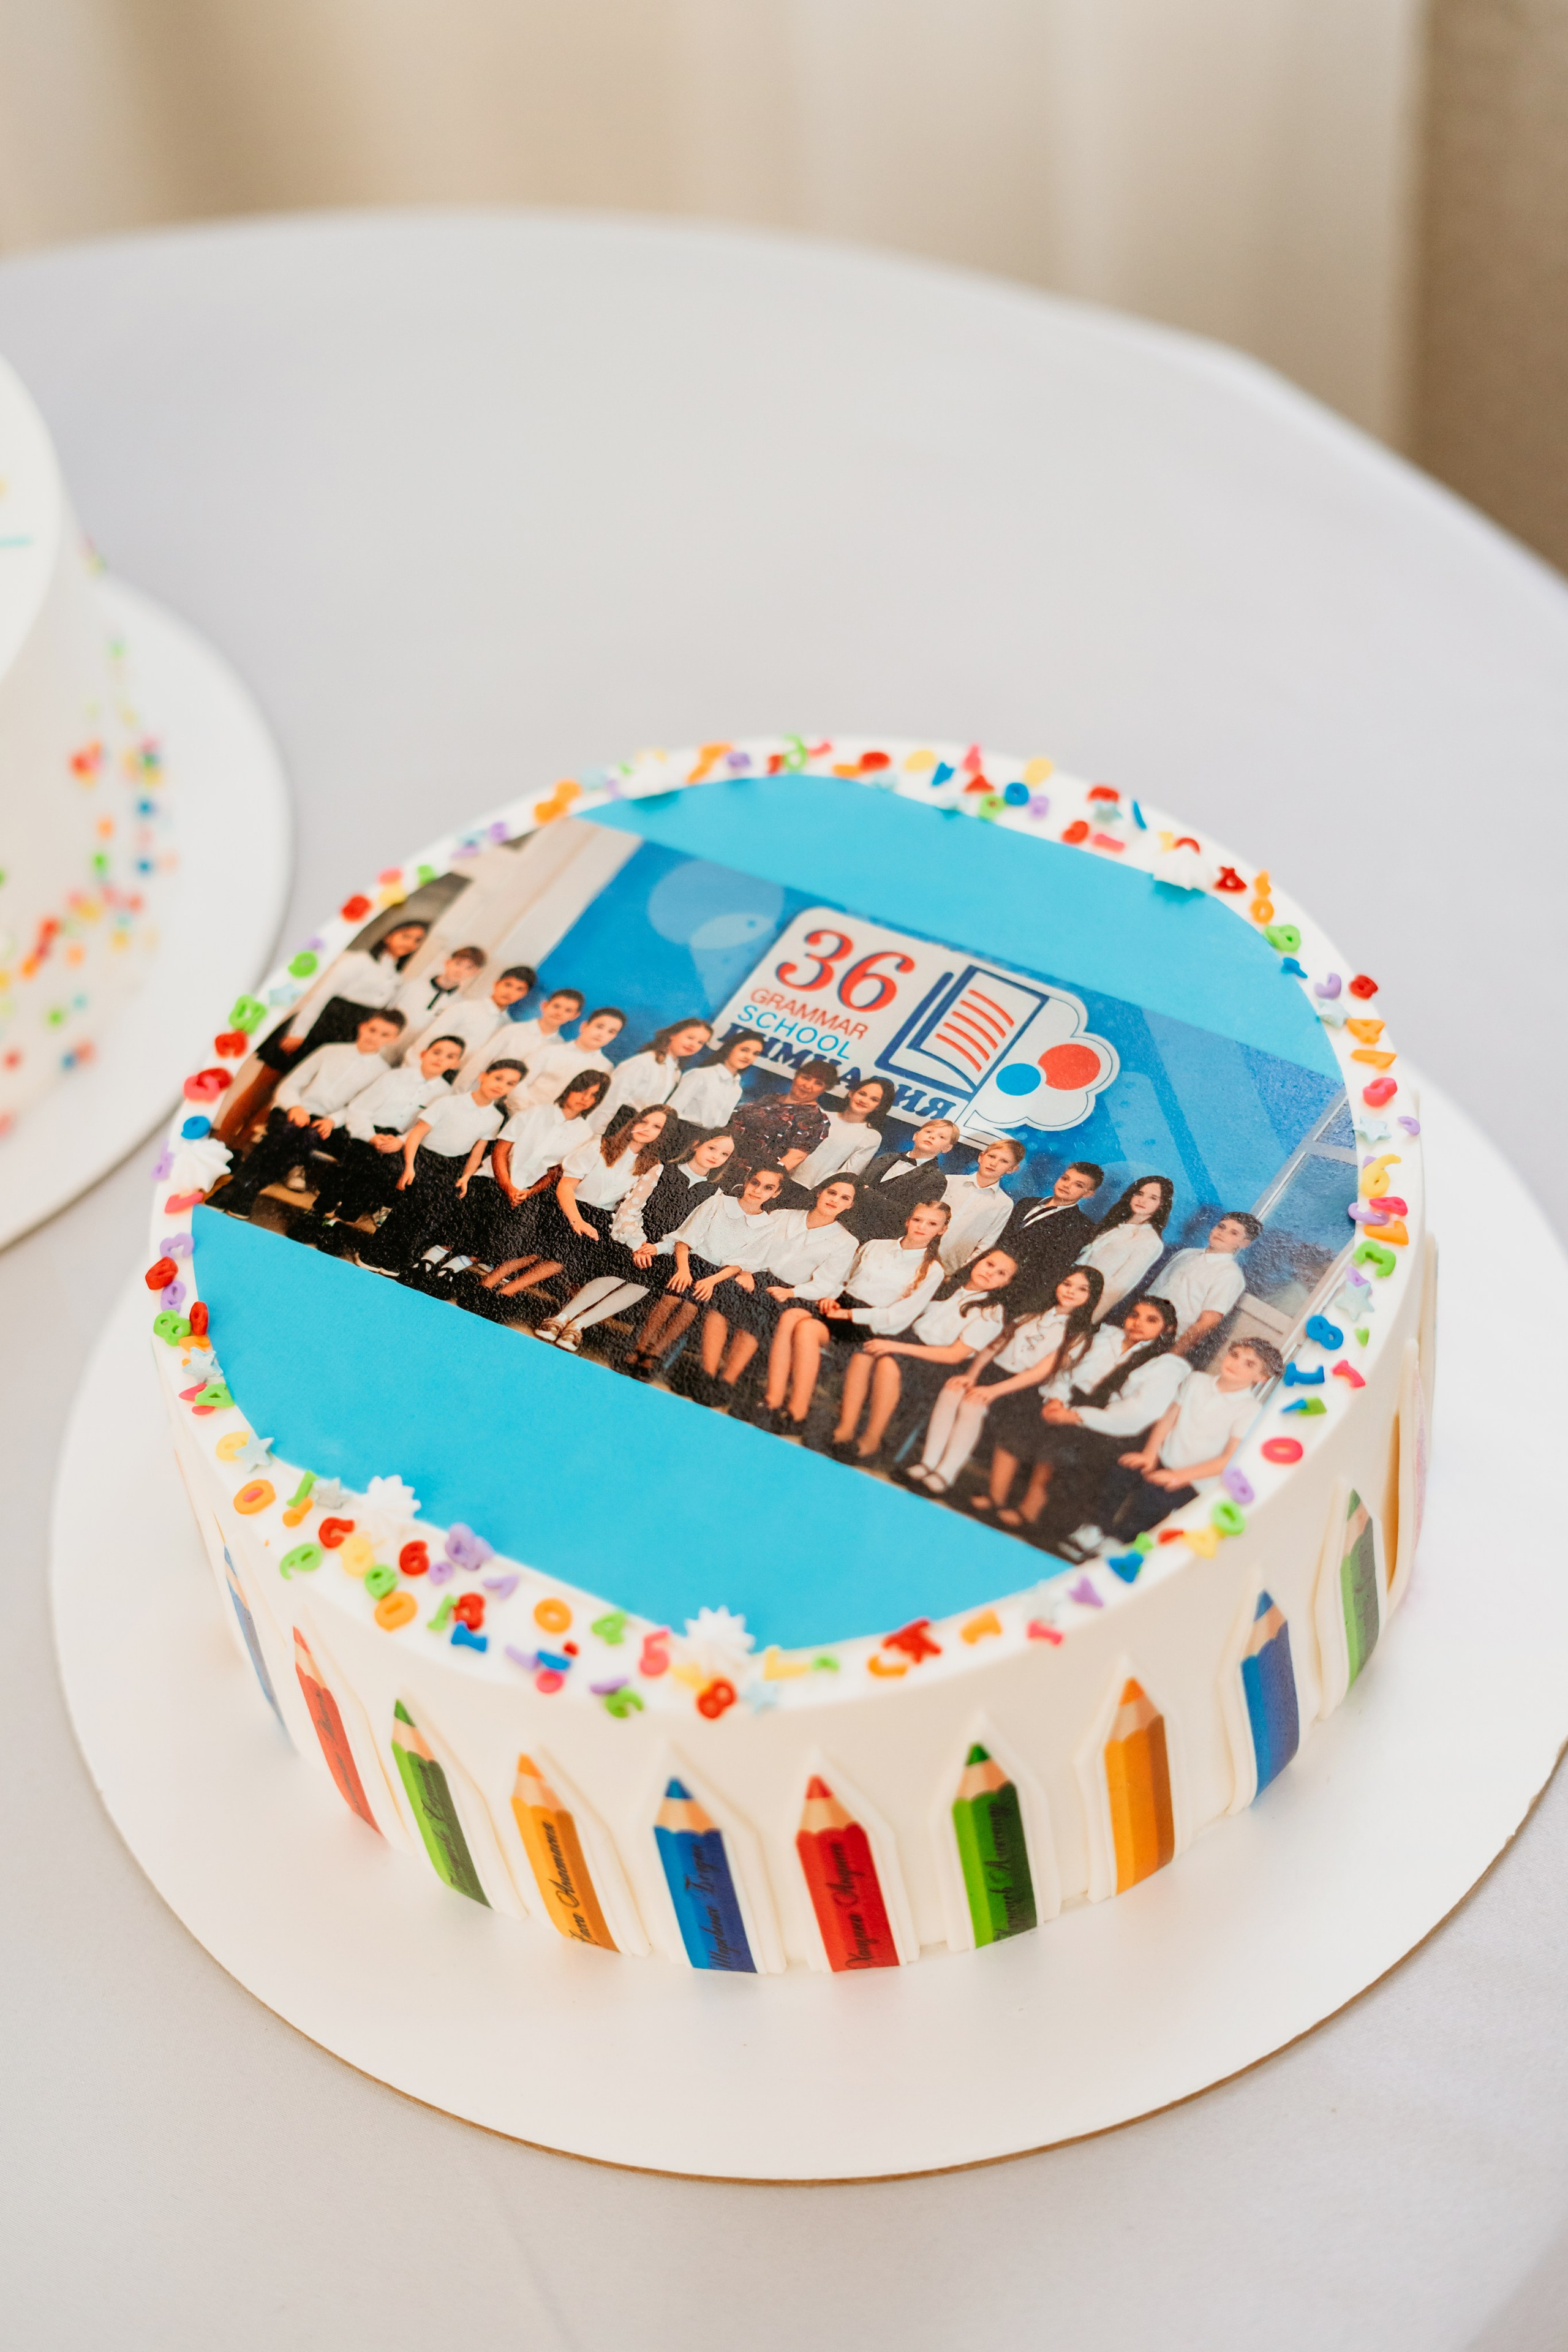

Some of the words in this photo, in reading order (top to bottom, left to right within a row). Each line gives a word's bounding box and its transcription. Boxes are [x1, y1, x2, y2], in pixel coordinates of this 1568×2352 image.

[777, 929, 915, 1012] 36
[737, 1005, 850, 1060] SCHOOL
[751, 988, 869, 1039] GRAMMAR
[718, 1023, 956, 1119] ГИМАИЯ
